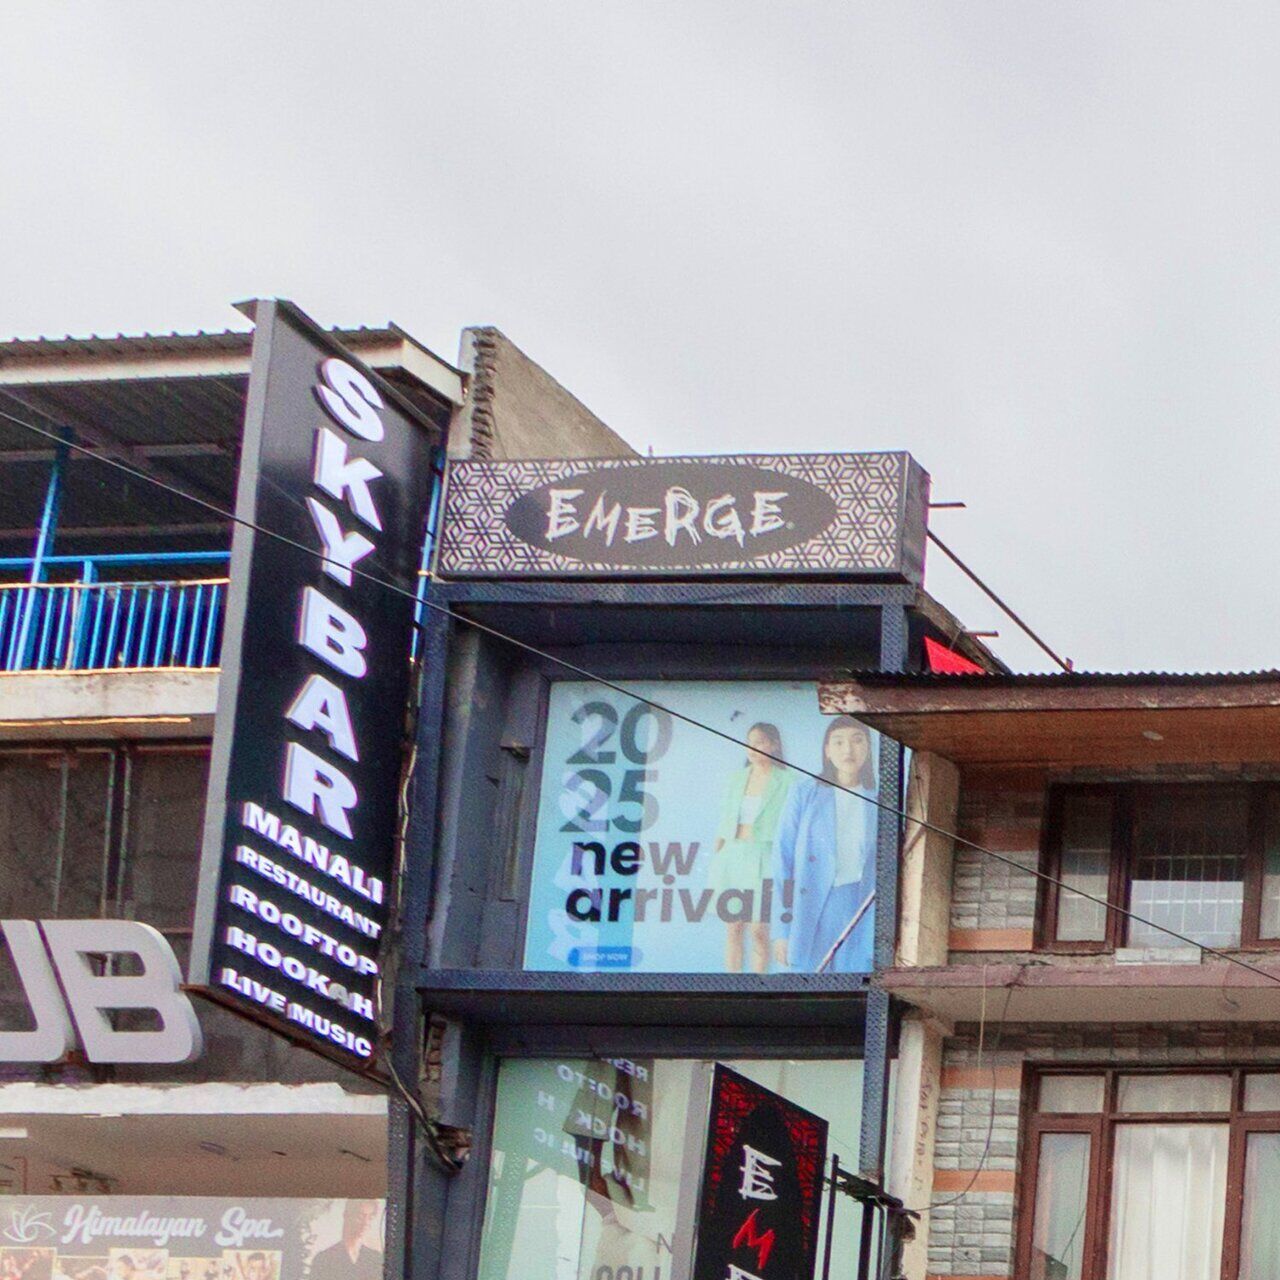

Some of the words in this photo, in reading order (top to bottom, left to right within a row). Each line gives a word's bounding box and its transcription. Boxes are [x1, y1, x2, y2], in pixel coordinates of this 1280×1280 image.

[545, 487, 791, 548] EMERGE
[284, 356, 385, 840] SKYBAR
[565, 701, 673, 766] 20
[559, 769, 660, 833] 25
[236, 845, 382, 939] RESTAURANT
[243, 802, 383, 905] MANALI
[570, 839, 701, 876] new
[230, 885, 379, 975] ROOFTOP
[565, 869, 795, 923] arrival!
[227, 926, 375, 1021] HOOKAH
[221, 967, 287, 1013] LIVE
[287, 1002, 372, 1058] MUSIC
[61, 1204, 207, 1246] Himalayan
[213, 1206, 284, 1248] Spa
